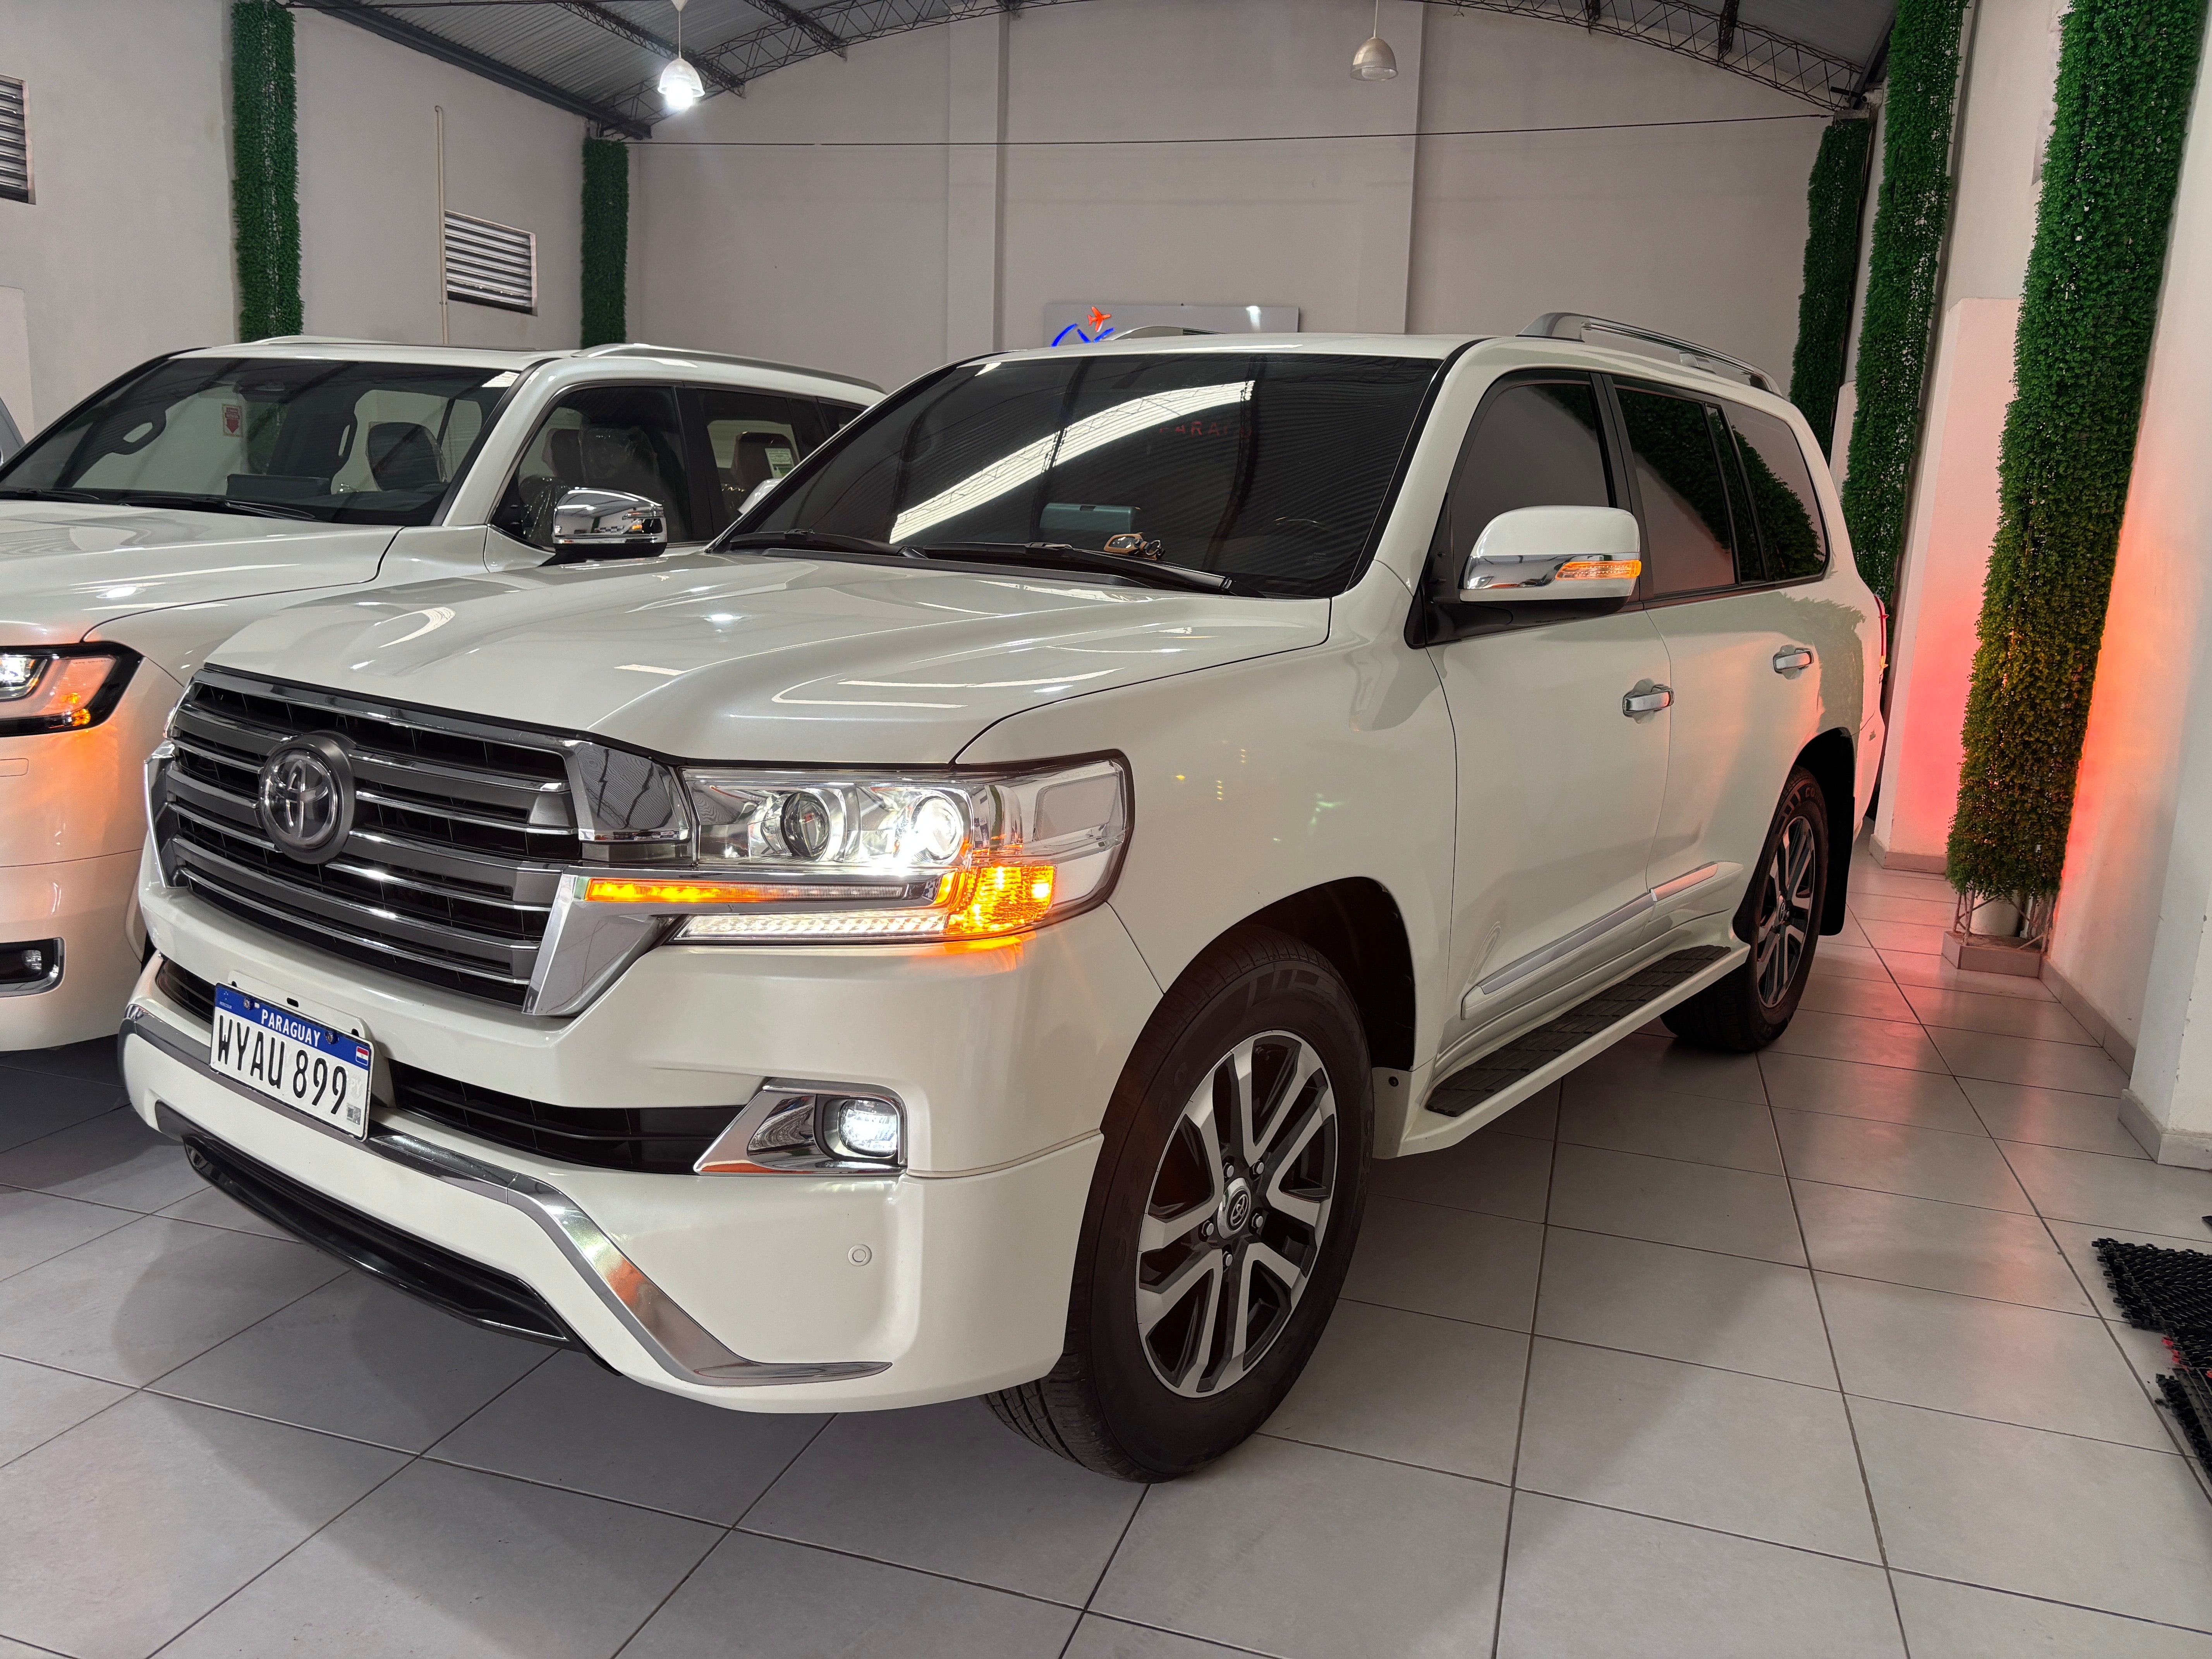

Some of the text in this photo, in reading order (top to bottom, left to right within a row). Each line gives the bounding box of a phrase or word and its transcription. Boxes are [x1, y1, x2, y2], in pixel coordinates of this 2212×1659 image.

[261, 1008, 321, 1047] PARAGUAY
[218, 1015, 347, 1115] WYAU 899
